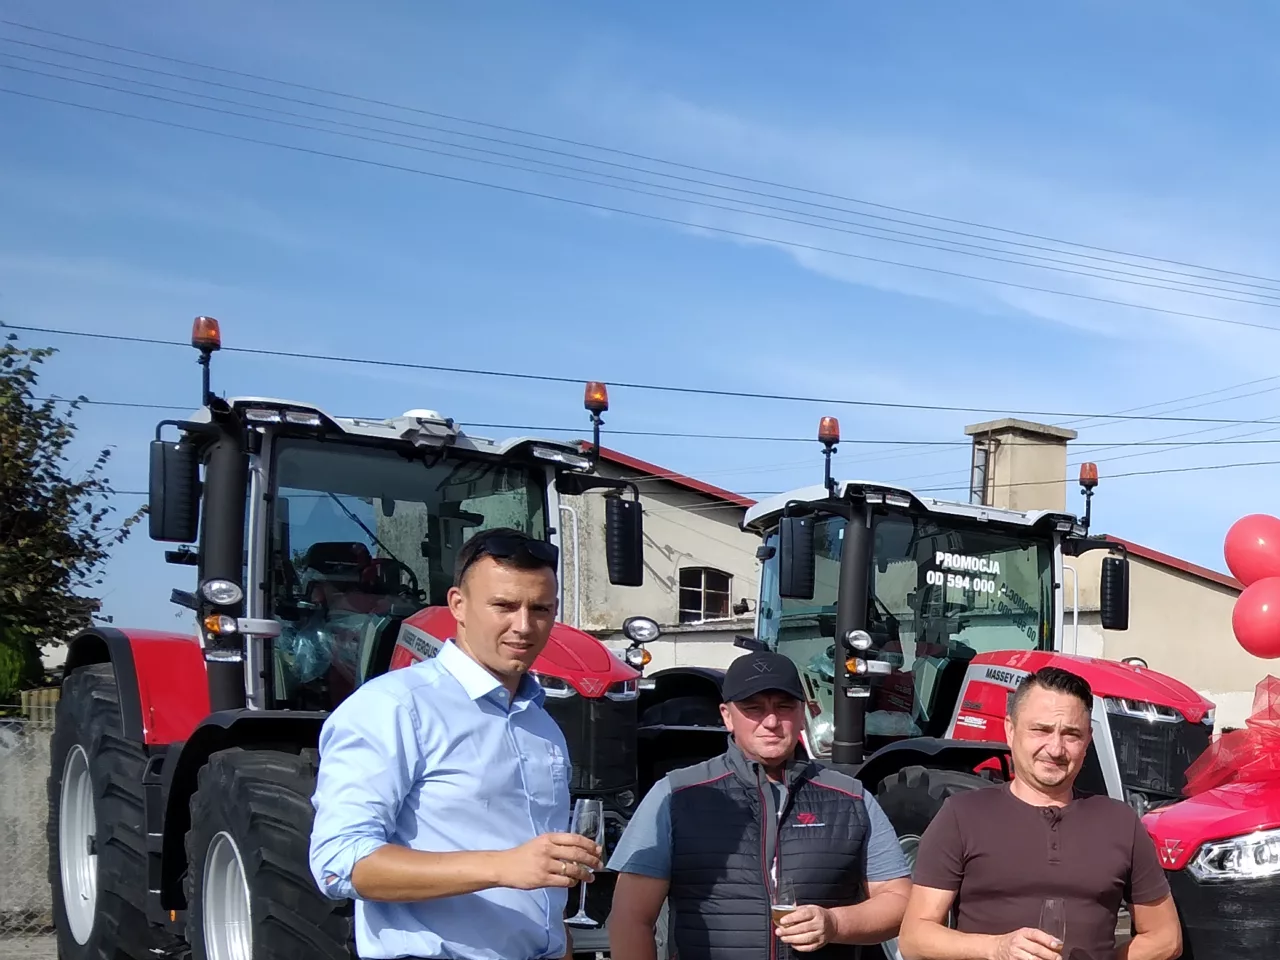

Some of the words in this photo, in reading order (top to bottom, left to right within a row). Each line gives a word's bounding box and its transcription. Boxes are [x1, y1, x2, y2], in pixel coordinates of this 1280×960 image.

[935, 551, 1000, 575] PROMOCJA
[926, 570, 944, 586] OD
[947, 573, 970, 590] 594
[973, 578, 995, 593] 000
[985, 668, 1015, 685] MASSEY
